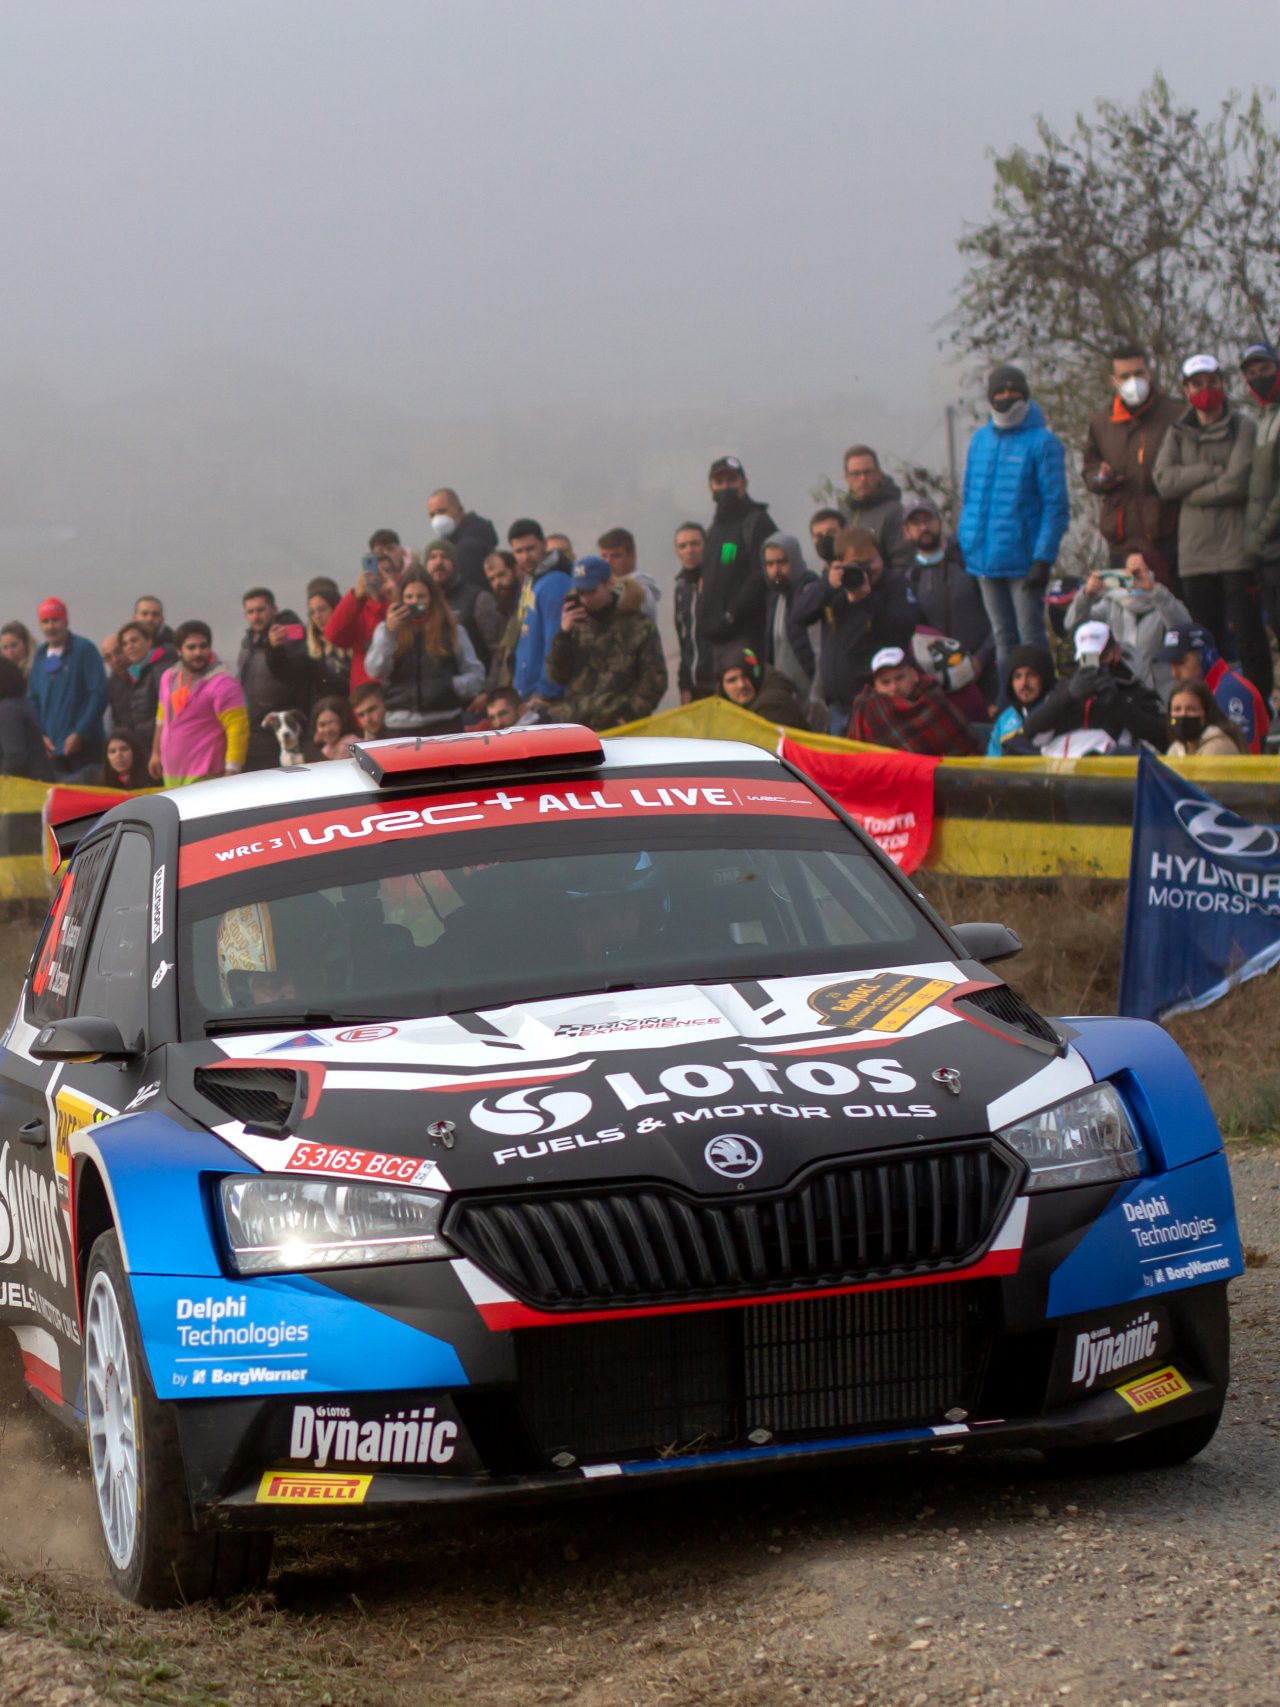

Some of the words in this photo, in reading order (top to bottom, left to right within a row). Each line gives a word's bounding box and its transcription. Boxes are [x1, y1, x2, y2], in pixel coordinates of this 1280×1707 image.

[539, 791, 623, 813] ALL
[630, 788, 733, 807] LIVE
[864, 812, 916, 833] TOYOTA
[215, 841, 264, 862] WRC
[269, 837, 283, 850] 3
[873, 832, 910, 849] AZOO
[1150, 851, 1280, 899] HYUNDA
[578, 1017, 722, 1037] EXPERIENCE
[580, 1016, 678, 1032] DRIVING
[606, 1058, 917, 1111] LOTOS
[493, 1127, 626, 1166] FUELS
[636, 1117, 666, 1134] &
[673, 1103, 832, 1125] MOTOR
[842, 1104, 937, 1118] OILS
[292, 1147, 310, 1166] S
[308, 1148, 365, 1171] 3165
[365, 1154, 417, 1178] BCG
[1123, 1196, 1170, 1223] Delphi
[15, 1160, 66, 1288] LOTOS
[1131, 1216, 1217, 1248] Technologies
[1143, 1273, 1154, 1287] by
[1166, 1257, 1230, 1281] BorgWarner
[176, 1296, 247, 1322] Delphi
[177, 1321, 309, 1347] Technologies
[1072, 1312, 1159, 1388] Dynamic
[173, 1372, 187, 1386] by
[211, 1367, 308, 1385] BorgWarner
[1126, 1372, 1183, 1407] PIRELLI
[326, 1406, 351, 1417] LOTOS
[290, 1405, 458, 1467] Dynamic
[268, 1476, 361, 1499] PIRELLI
